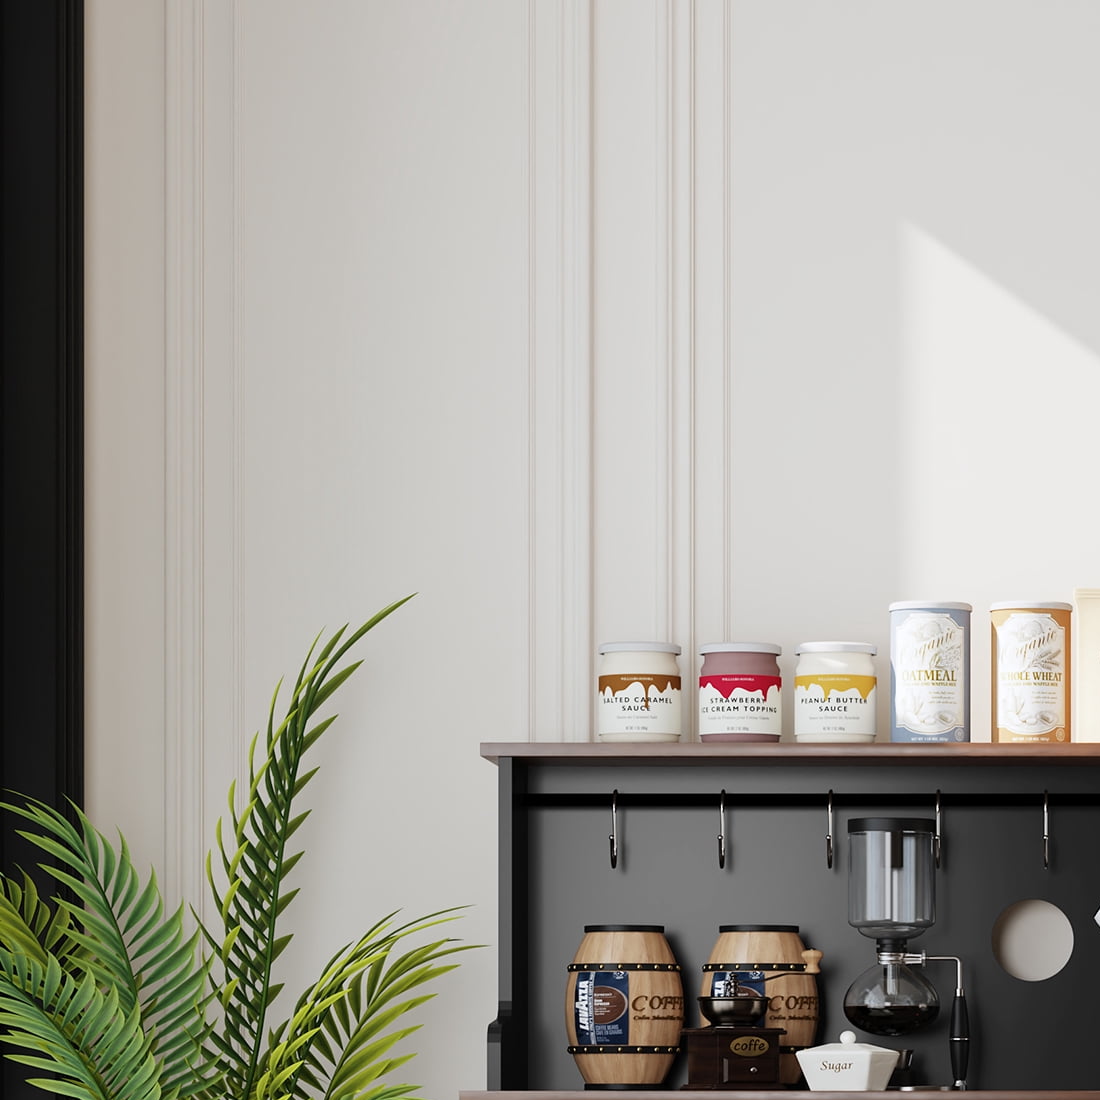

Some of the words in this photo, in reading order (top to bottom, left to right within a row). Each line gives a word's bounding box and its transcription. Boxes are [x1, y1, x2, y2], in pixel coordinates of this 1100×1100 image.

[902, 670, 957, 682] OATMEAL
[1032, 671, 1063, 682] WHEAT
[734, 1039, 766, 1051] coffe
[820, 1060, 853, 1073] Sugar
